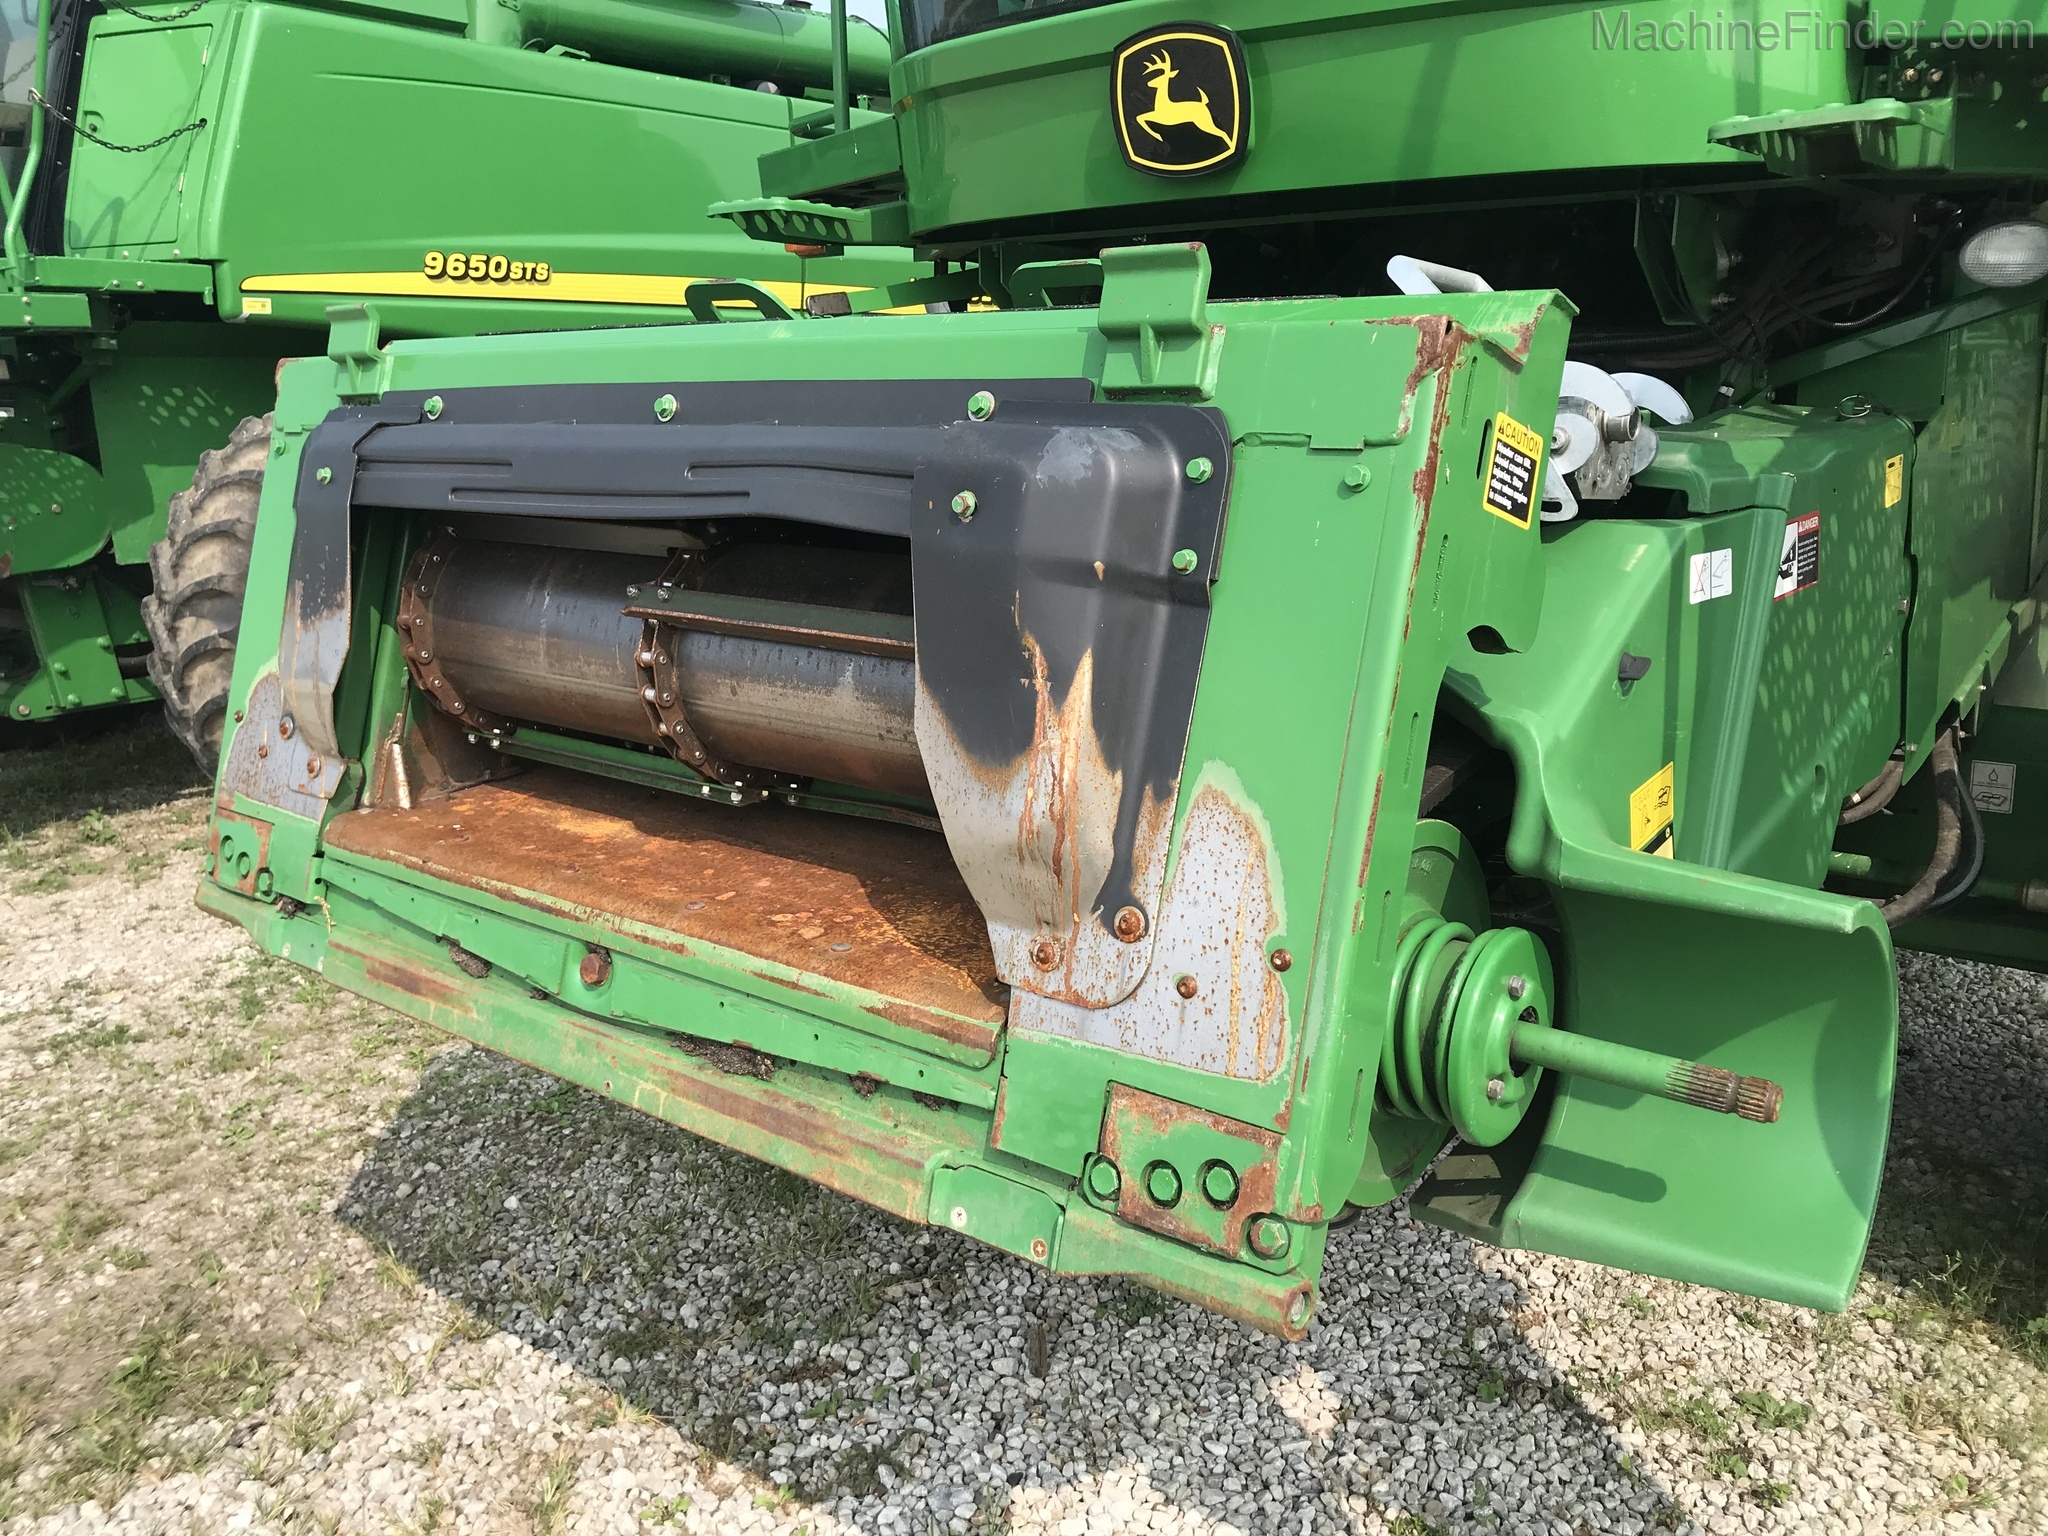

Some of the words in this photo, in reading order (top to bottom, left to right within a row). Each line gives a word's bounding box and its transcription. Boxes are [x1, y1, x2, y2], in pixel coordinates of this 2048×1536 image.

[1505, 422, 1541, 456] CAUTION
[1495, 453, 1509, 469] Avoid
[1508, 463, 1529, 482] crushing
[1512, 475, 1523, 491] Stay
[1802, 516, 1819, 531] DANGER
